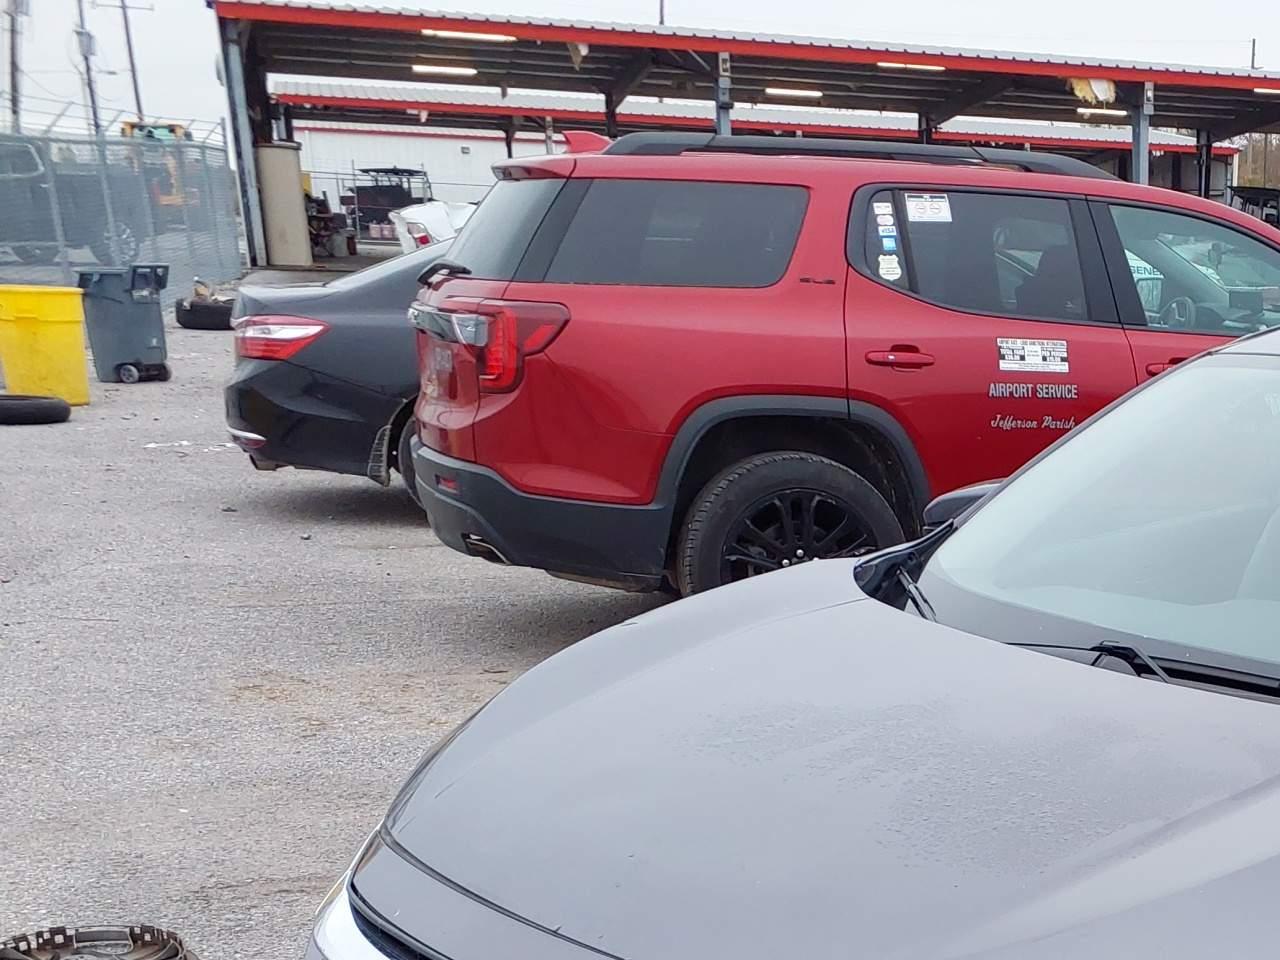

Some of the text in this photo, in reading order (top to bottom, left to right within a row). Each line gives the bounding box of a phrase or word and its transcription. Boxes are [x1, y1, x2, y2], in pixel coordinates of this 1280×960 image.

[988, 383, 1078, 399] AIRPORT SERVICE
[991, 414, 1076, 430] Jefferson Parish
